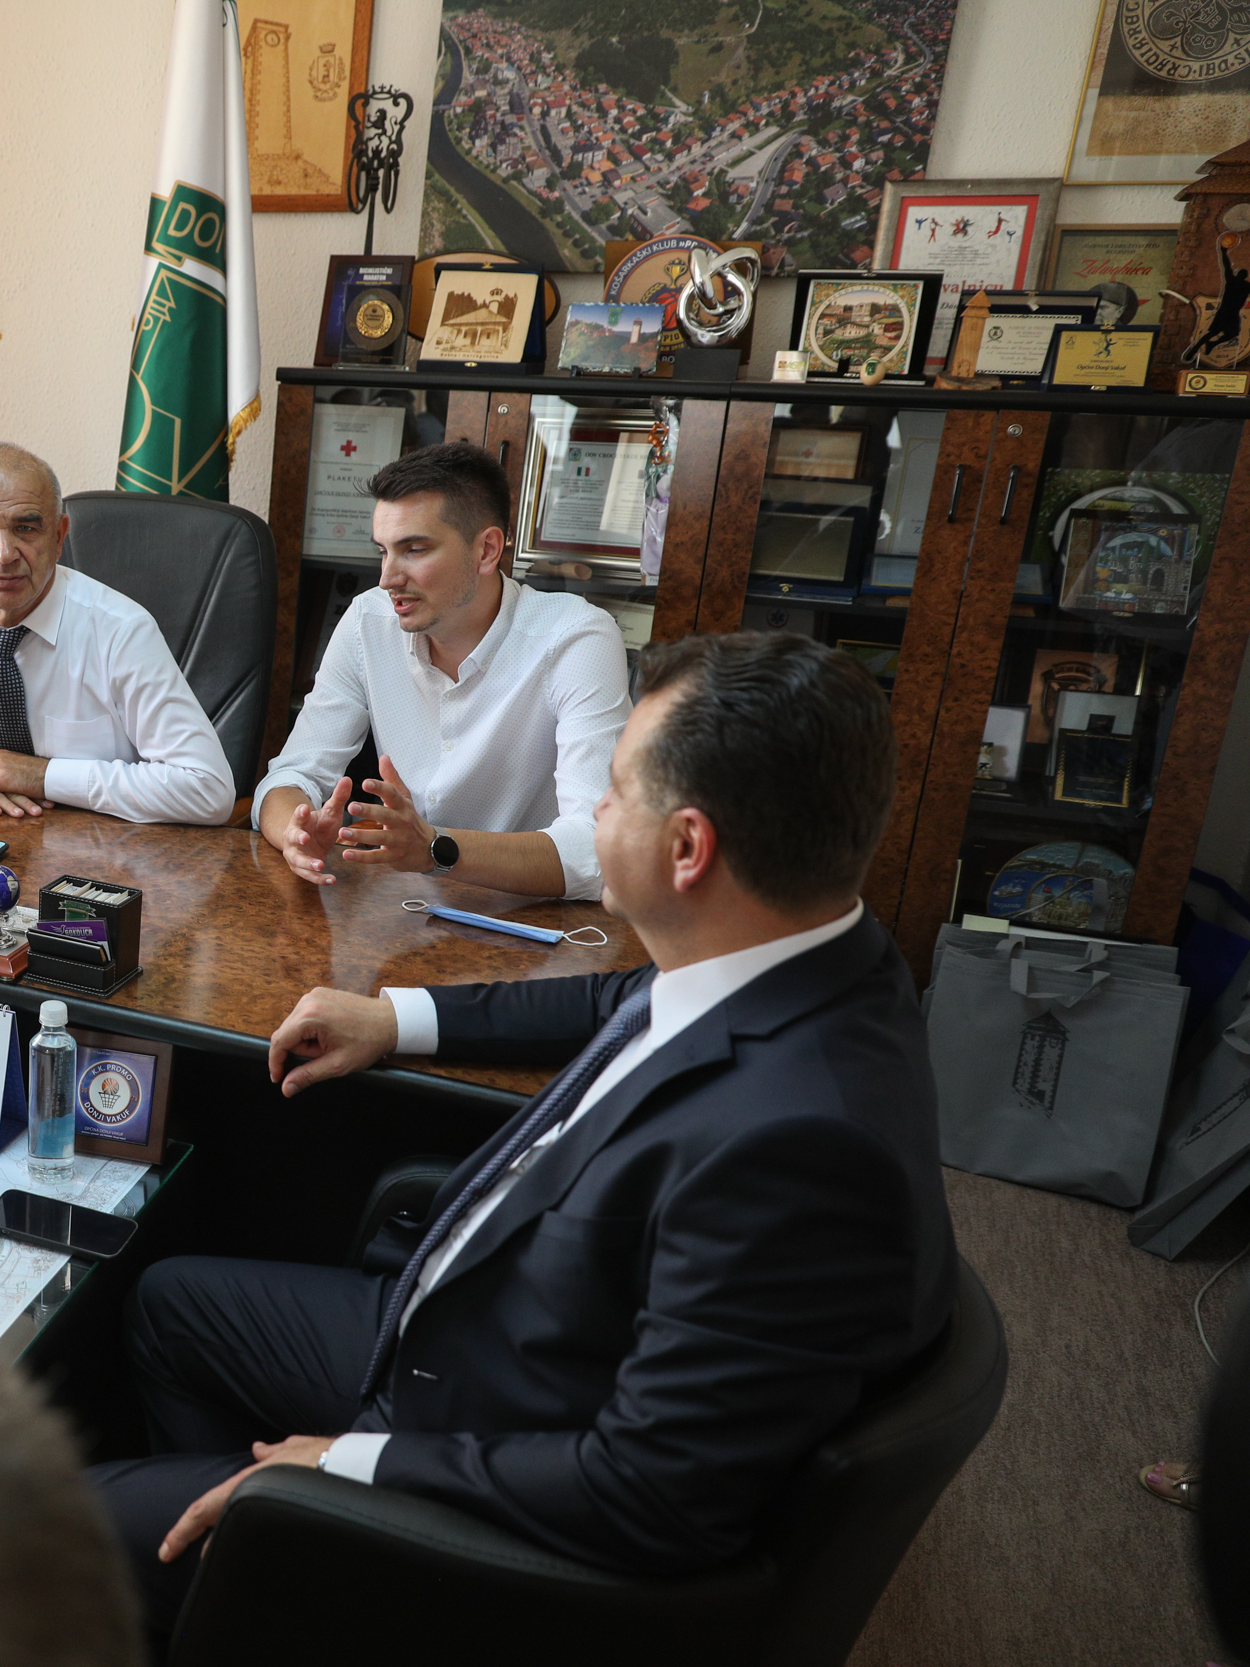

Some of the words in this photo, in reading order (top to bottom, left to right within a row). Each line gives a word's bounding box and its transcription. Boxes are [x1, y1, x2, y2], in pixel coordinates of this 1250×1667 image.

[652, 239, 678, 252] KLUB
[941, 279, 1004, 294] valnicu
[92, 1066, 106, 1075] K.K.
[106, 1064, 132, 1081] PROMO
[84, 1101, 104, 1120] DONJI
[106, 1109, 130, 1122] VAKUF
